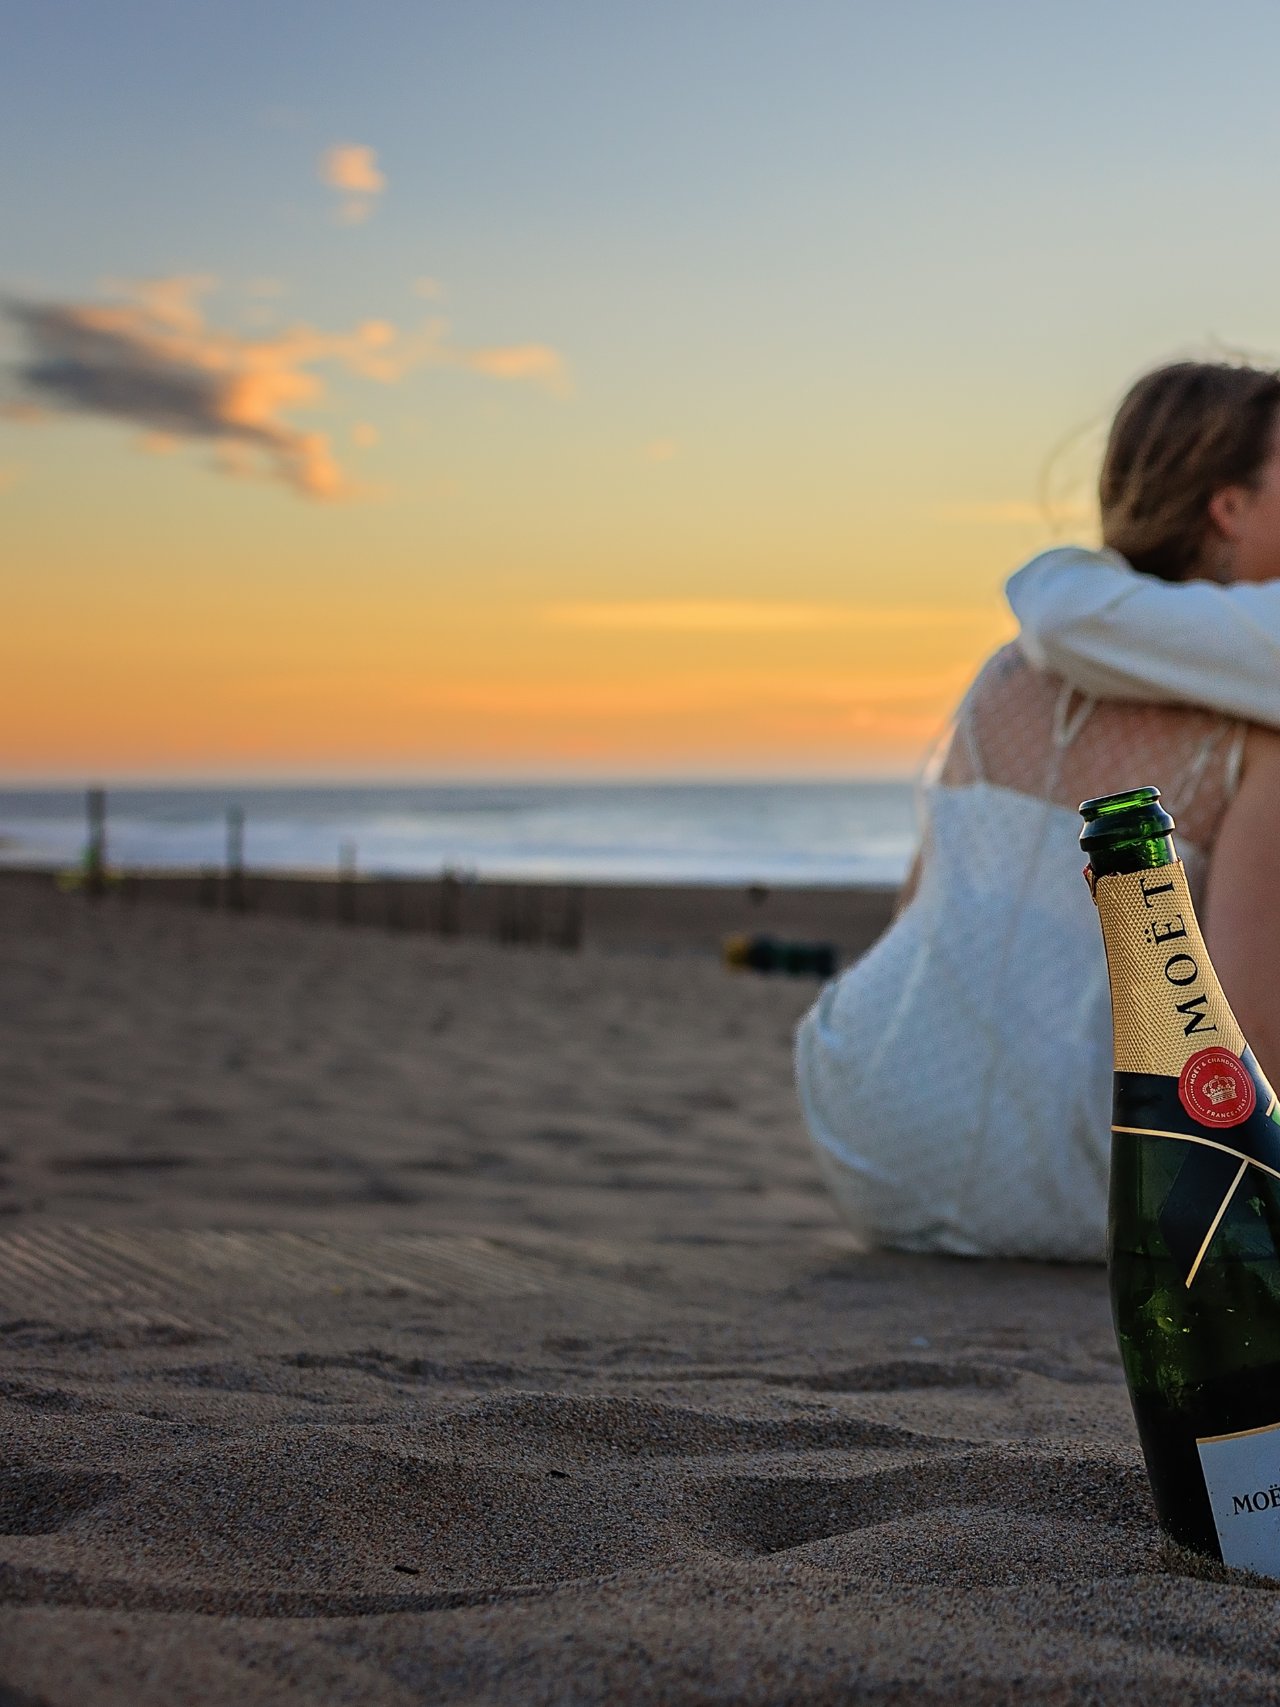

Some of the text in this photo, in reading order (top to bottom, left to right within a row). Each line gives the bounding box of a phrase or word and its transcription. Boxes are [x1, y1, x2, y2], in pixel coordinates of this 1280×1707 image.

[1140, 878, 1218, 1037] MOËT
[1207, 1058, 1238, 1072] CHANDON
[1206, 1109, 1235, 1118] FRANCE
